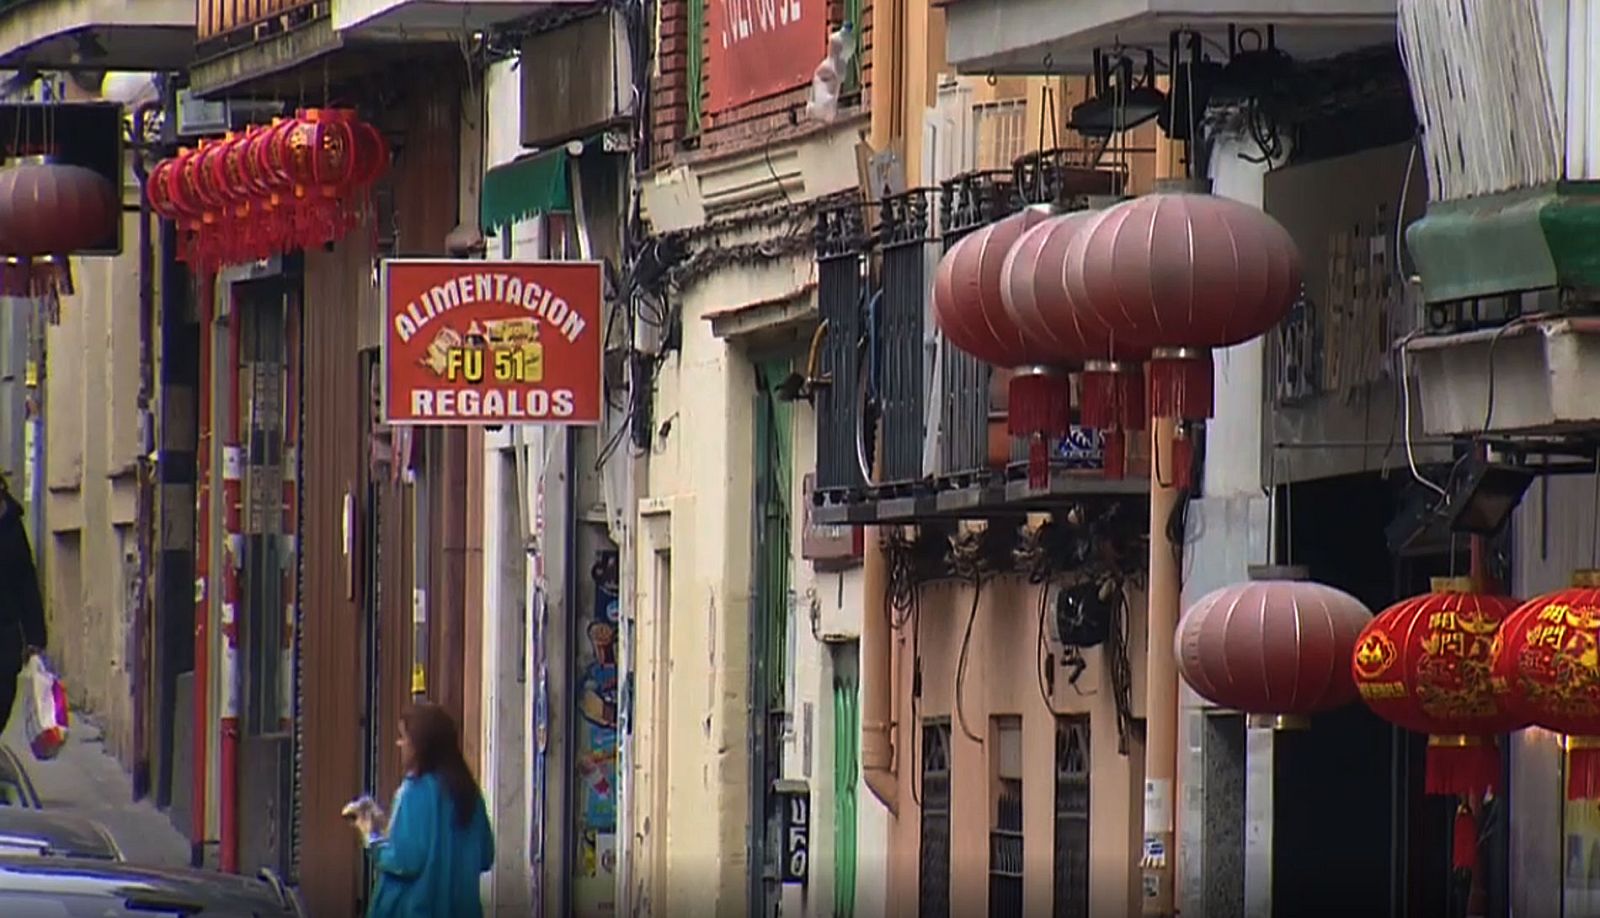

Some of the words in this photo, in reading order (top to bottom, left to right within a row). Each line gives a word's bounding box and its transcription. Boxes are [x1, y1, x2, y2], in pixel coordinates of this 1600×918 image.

[394, 273, 586, 343] ALIMENTACION
[447, 350, 484, 382] FU
[411, 389, 575, 416] REGALOS
